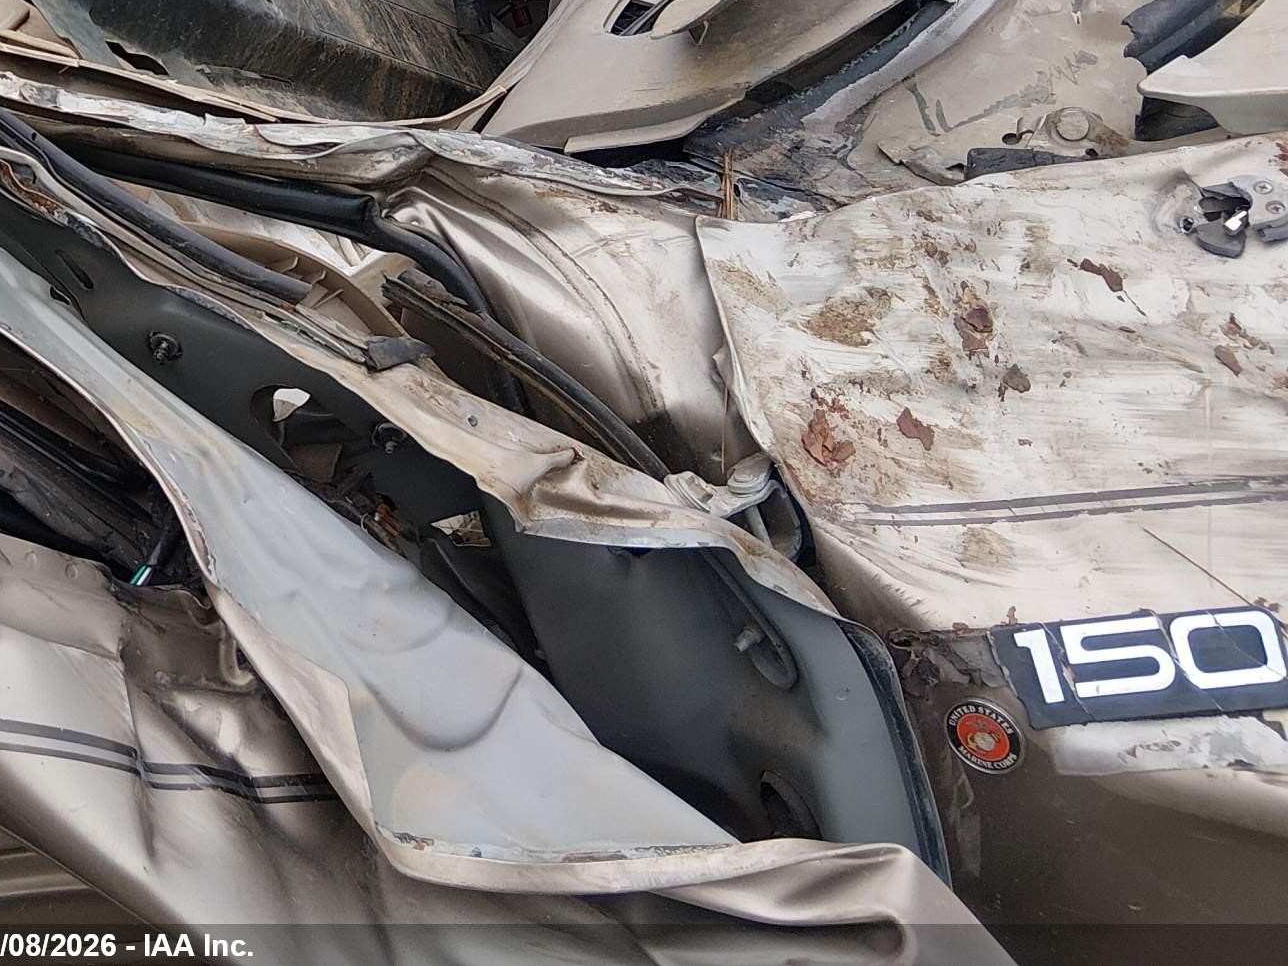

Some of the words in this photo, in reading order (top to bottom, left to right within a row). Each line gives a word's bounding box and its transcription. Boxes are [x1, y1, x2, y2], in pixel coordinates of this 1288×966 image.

[1013, 610, 1287, 703] 150
[948, 705, 976, 726] UNITED
[977, 706, 1014, 734] STATES
[958, 745, 993, 769] MARINE
